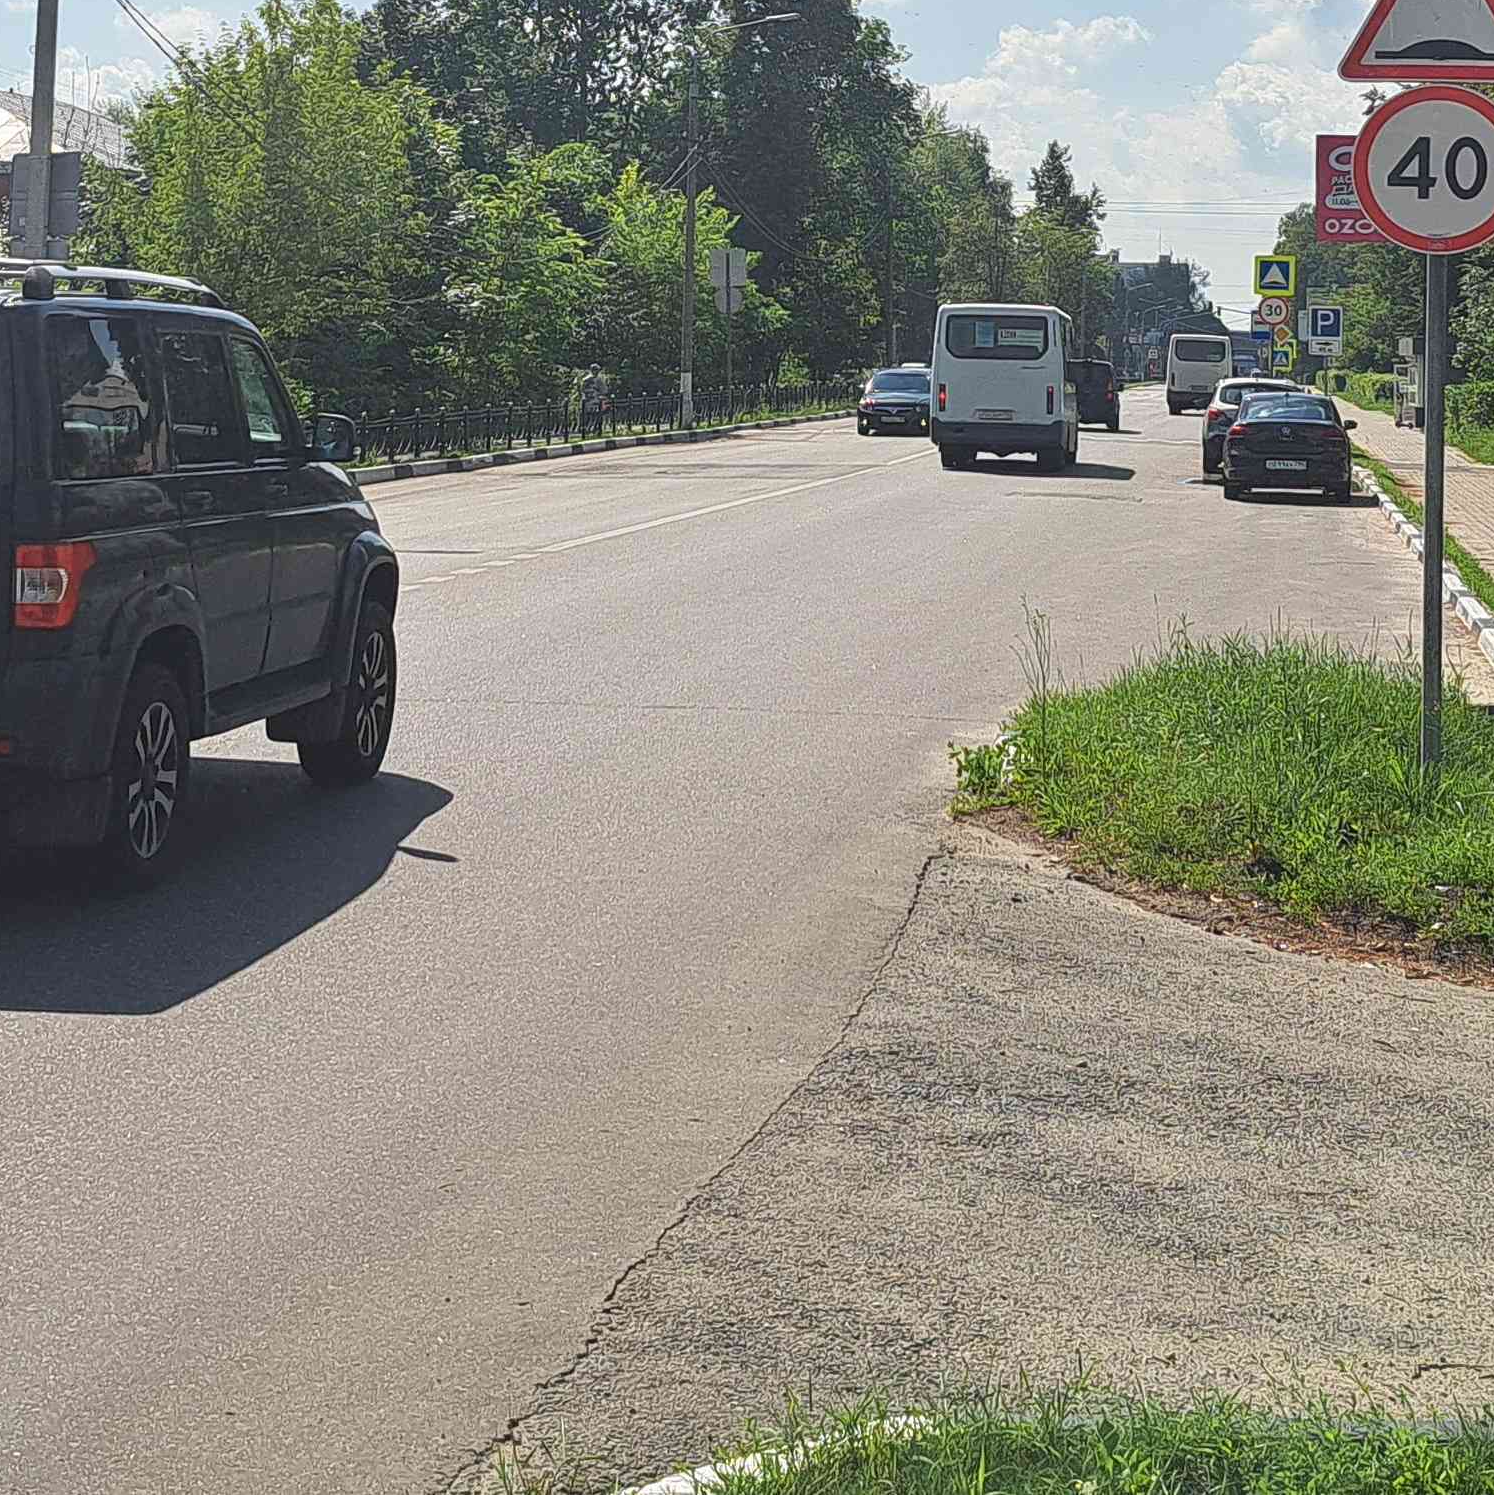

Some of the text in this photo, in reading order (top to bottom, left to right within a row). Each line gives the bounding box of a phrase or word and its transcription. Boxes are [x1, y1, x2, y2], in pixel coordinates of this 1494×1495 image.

[1387, 136, 1488, 200] 40
[1325, 218, 1375, 234] OZO
[1265, 304, 1282, 317] 30
[1317, 310, 1334, 335] P
